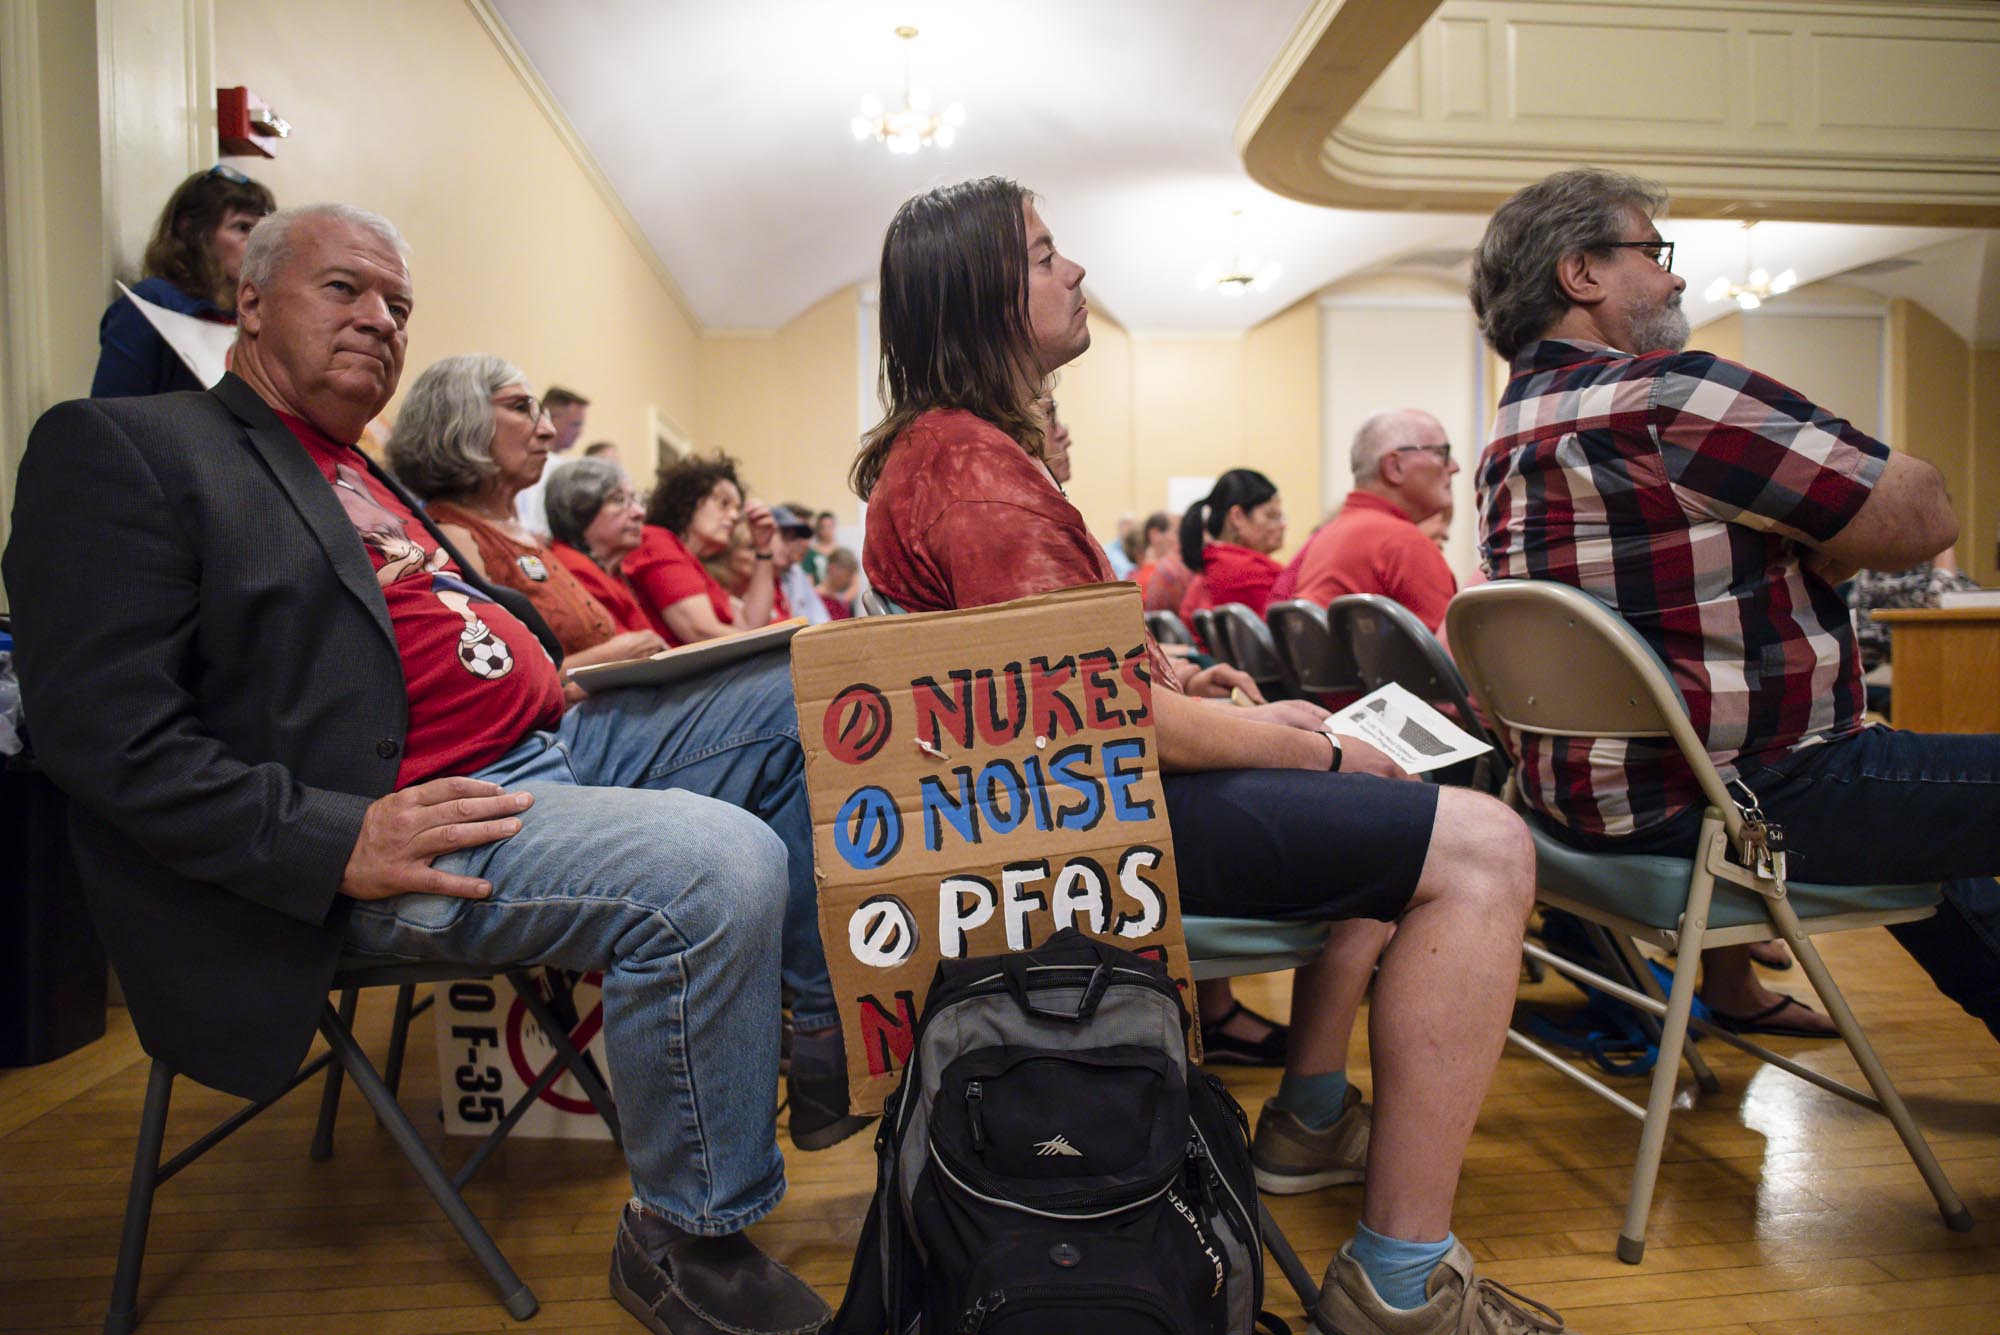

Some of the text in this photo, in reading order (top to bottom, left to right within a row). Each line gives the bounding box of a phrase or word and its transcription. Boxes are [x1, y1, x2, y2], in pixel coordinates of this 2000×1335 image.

[910, 644, 1153, 751] NUKES
[919, 737, 1155, 851] NOISE
[940, 845, 1167, 958] PFAS
[449, 975, 506, 1123] O F-35
